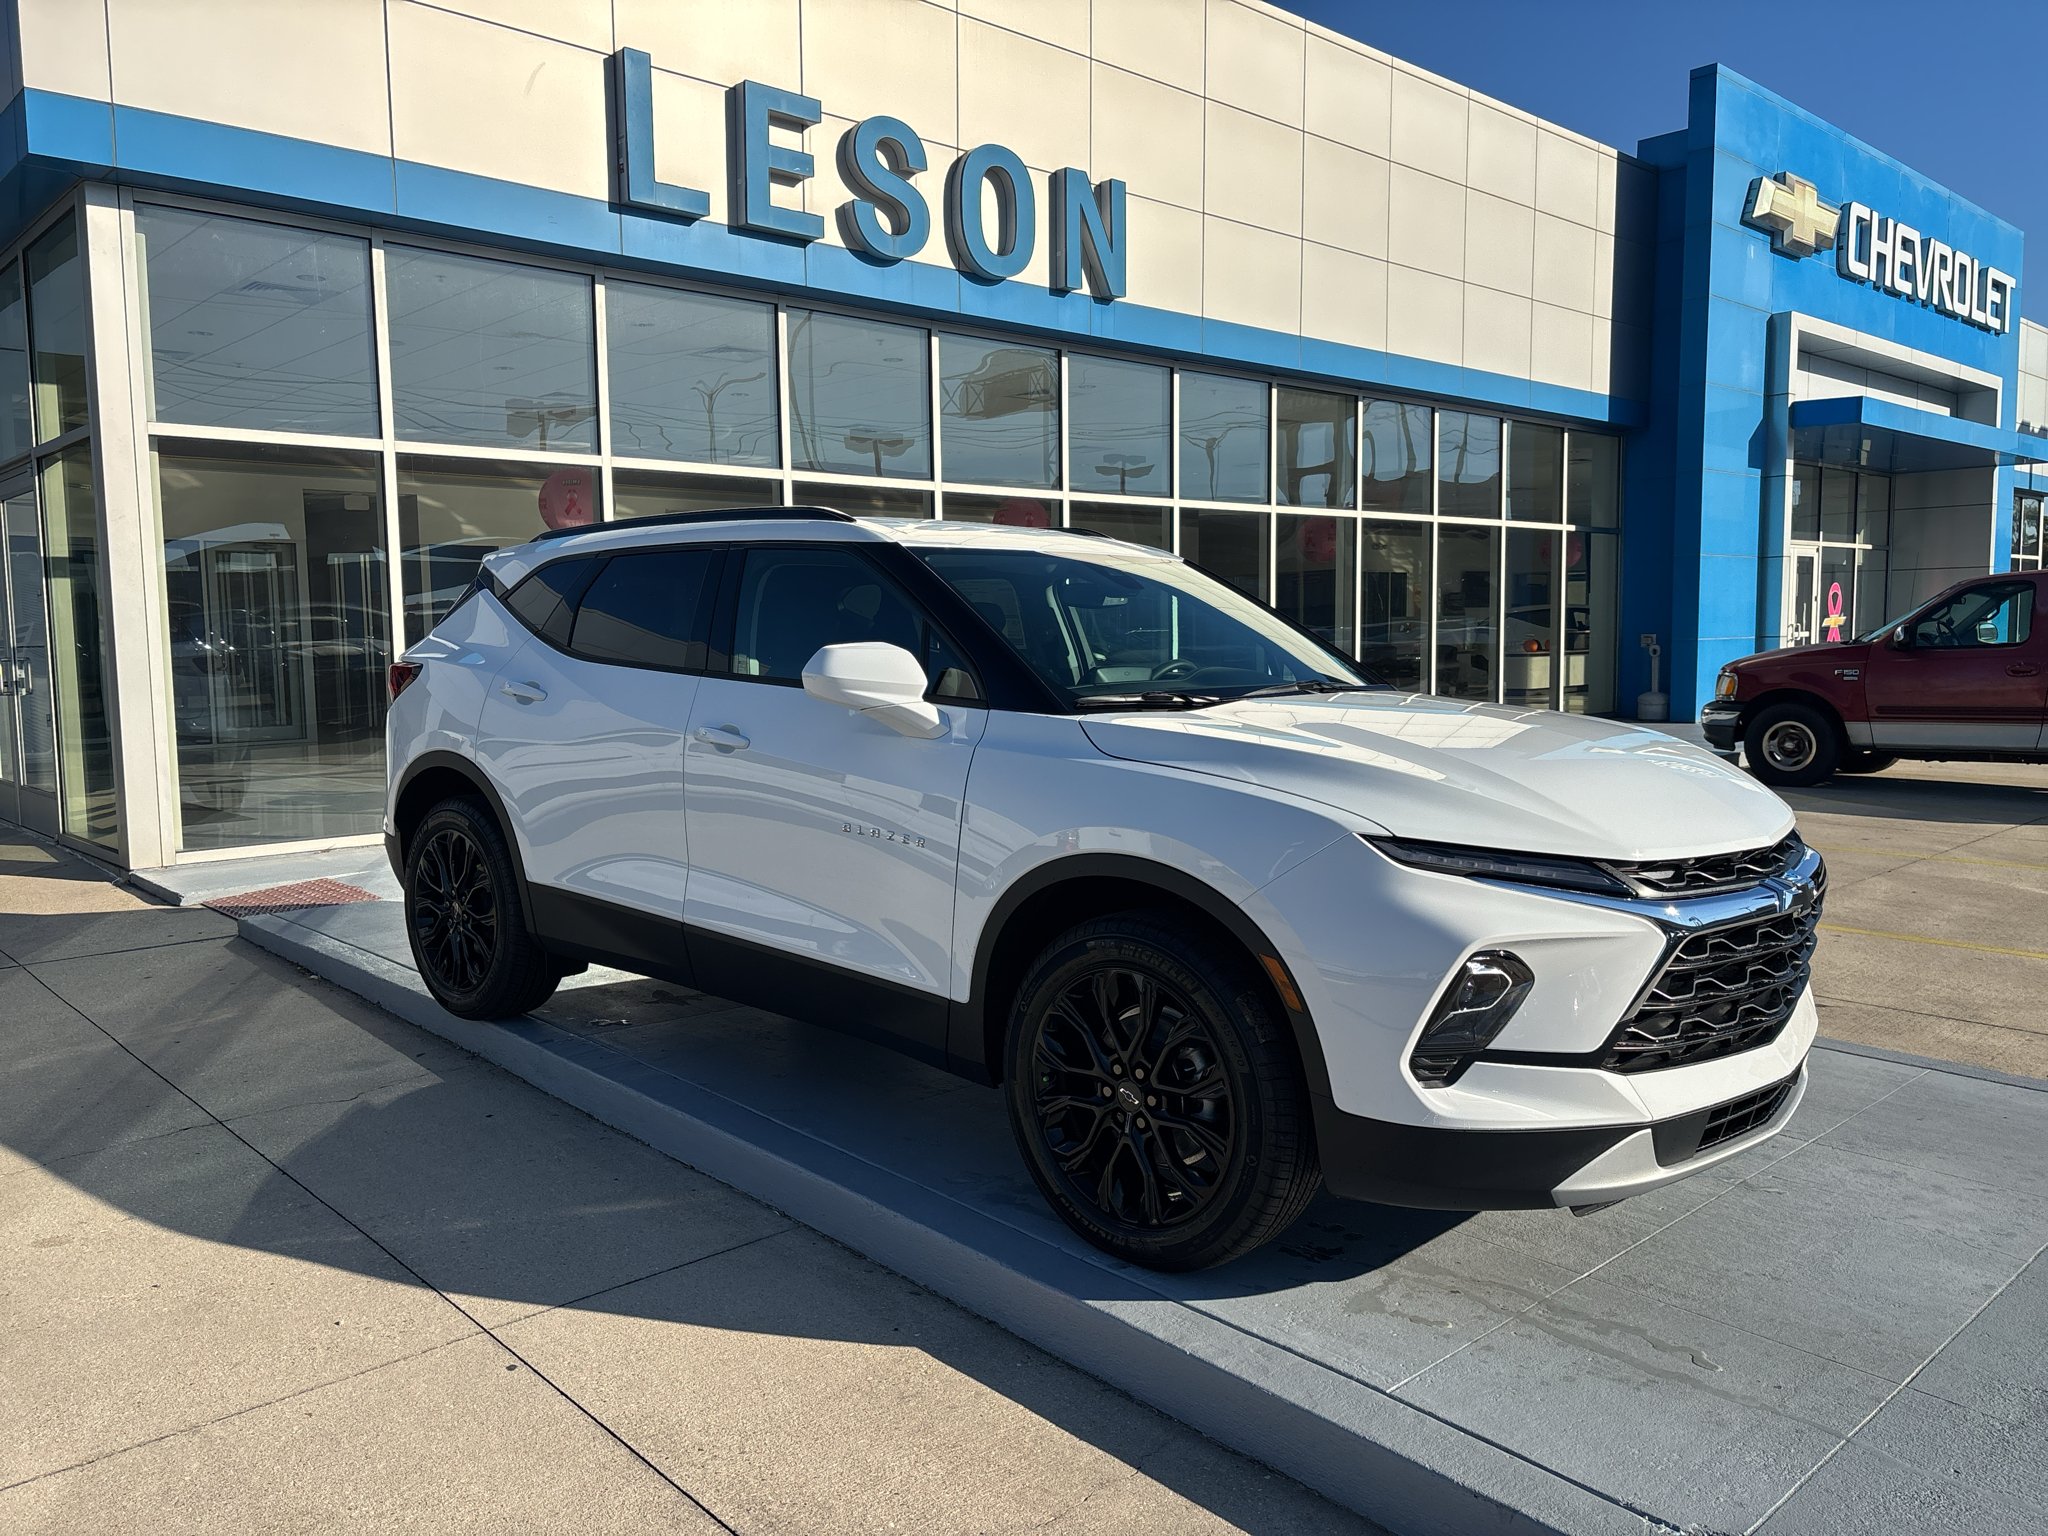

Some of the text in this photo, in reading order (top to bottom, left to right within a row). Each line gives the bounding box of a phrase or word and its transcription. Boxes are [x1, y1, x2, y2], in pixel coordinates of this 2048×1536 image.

[612, 47, 1127, 300] LESON
[1842, 200, 2017, 336] CHEVROLET
[841, 823, 926, 849] BLAZER
